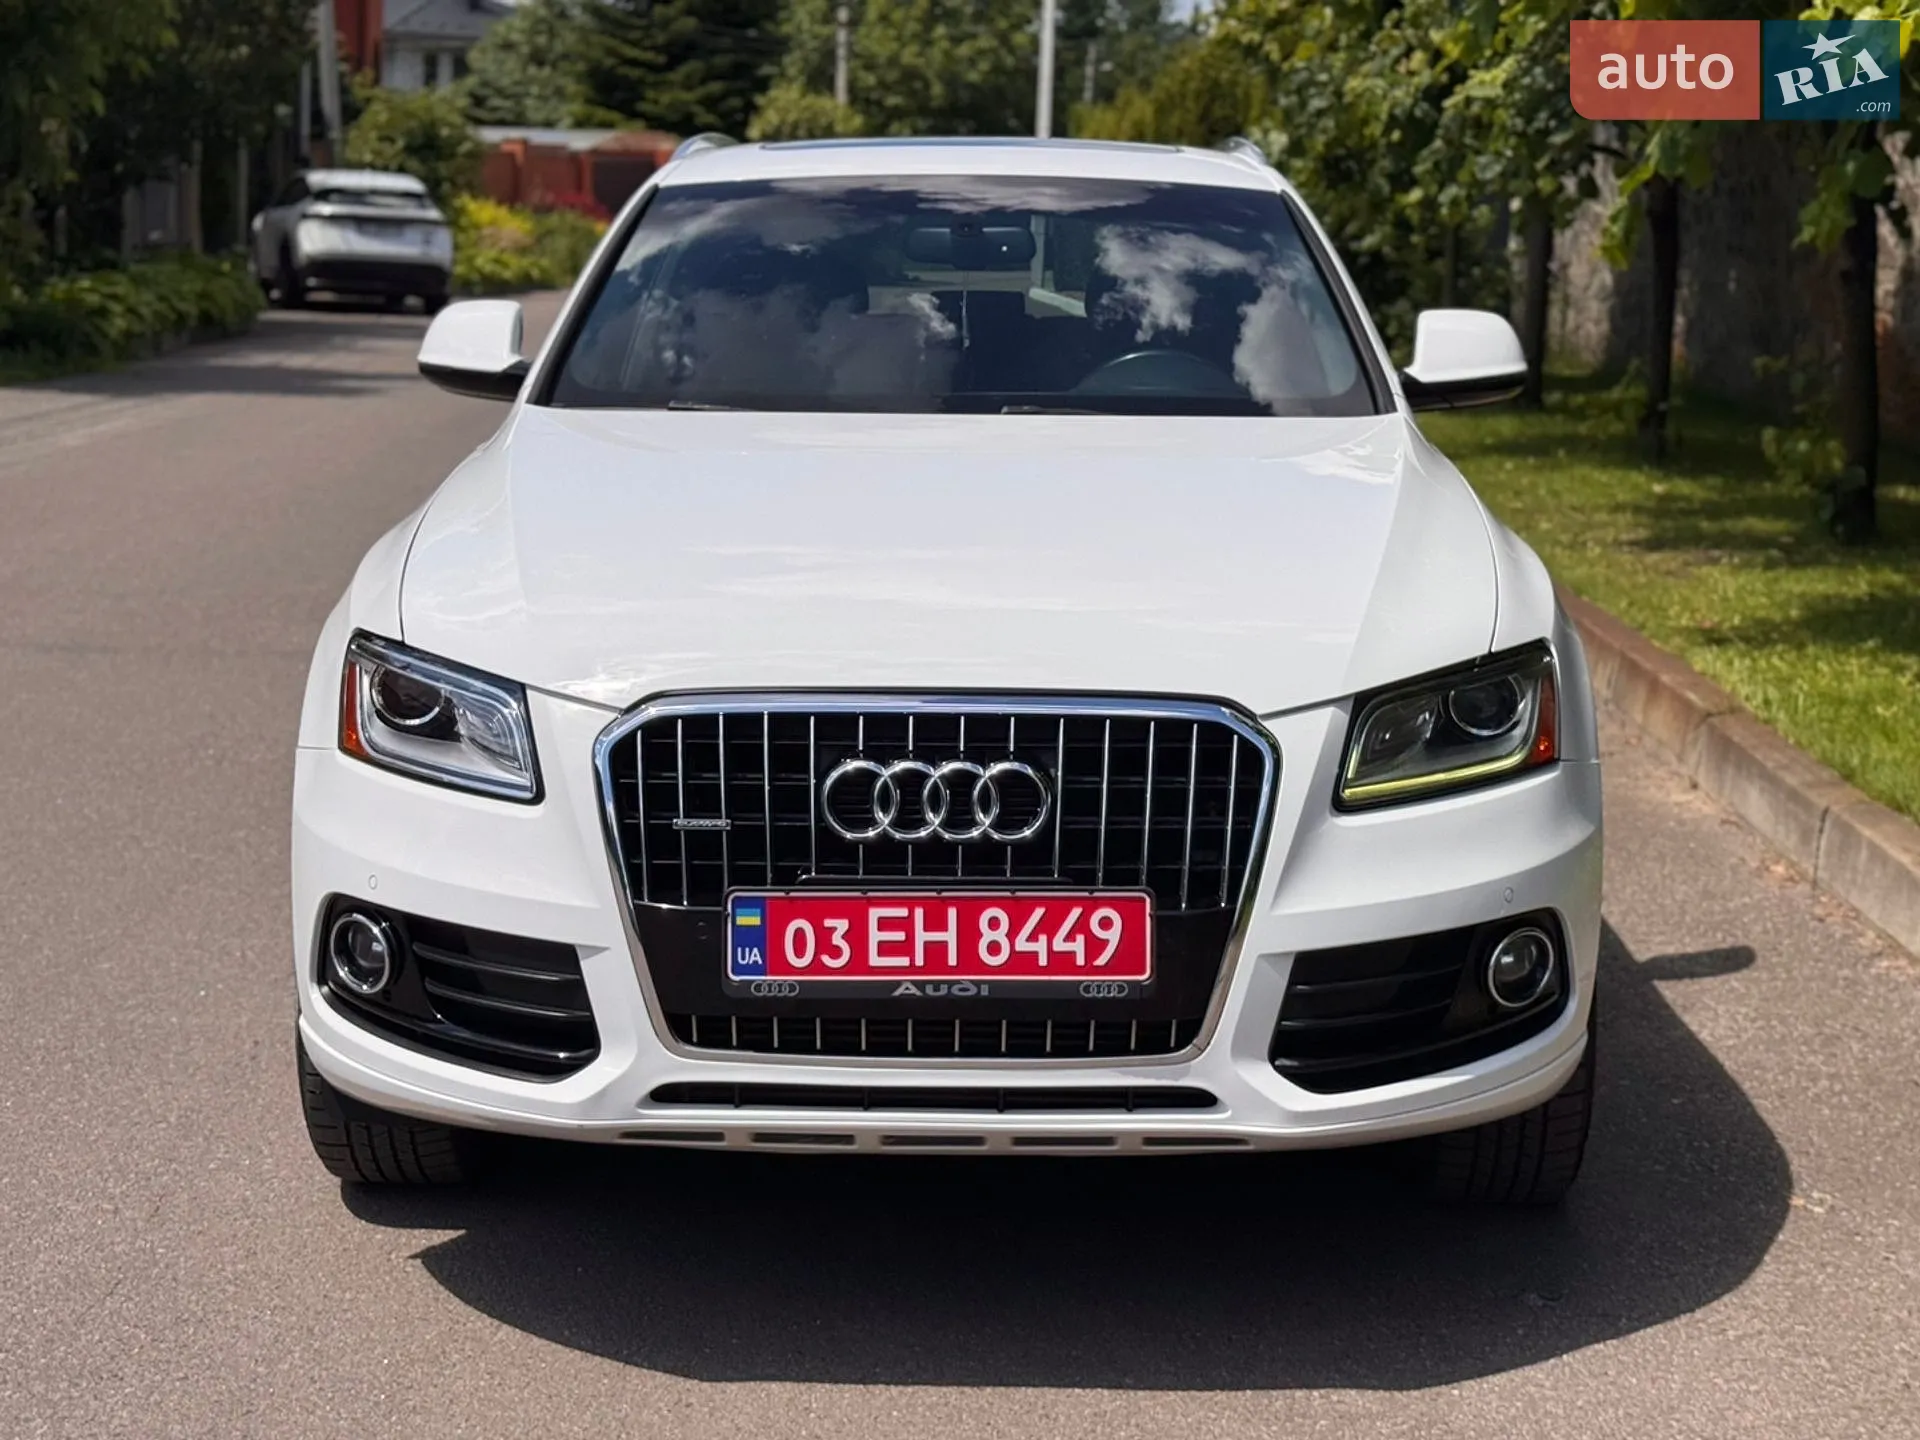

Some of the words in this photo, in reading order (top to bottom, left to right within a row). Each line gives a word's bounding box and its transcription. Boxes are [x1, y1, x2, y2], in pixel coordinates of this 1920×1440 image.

[736, 946, 763, 966] UA
[783, 918, 852, 969] 03
[867, 906, 958, 968] EH
[977, 906, 1124, 968] 8449
